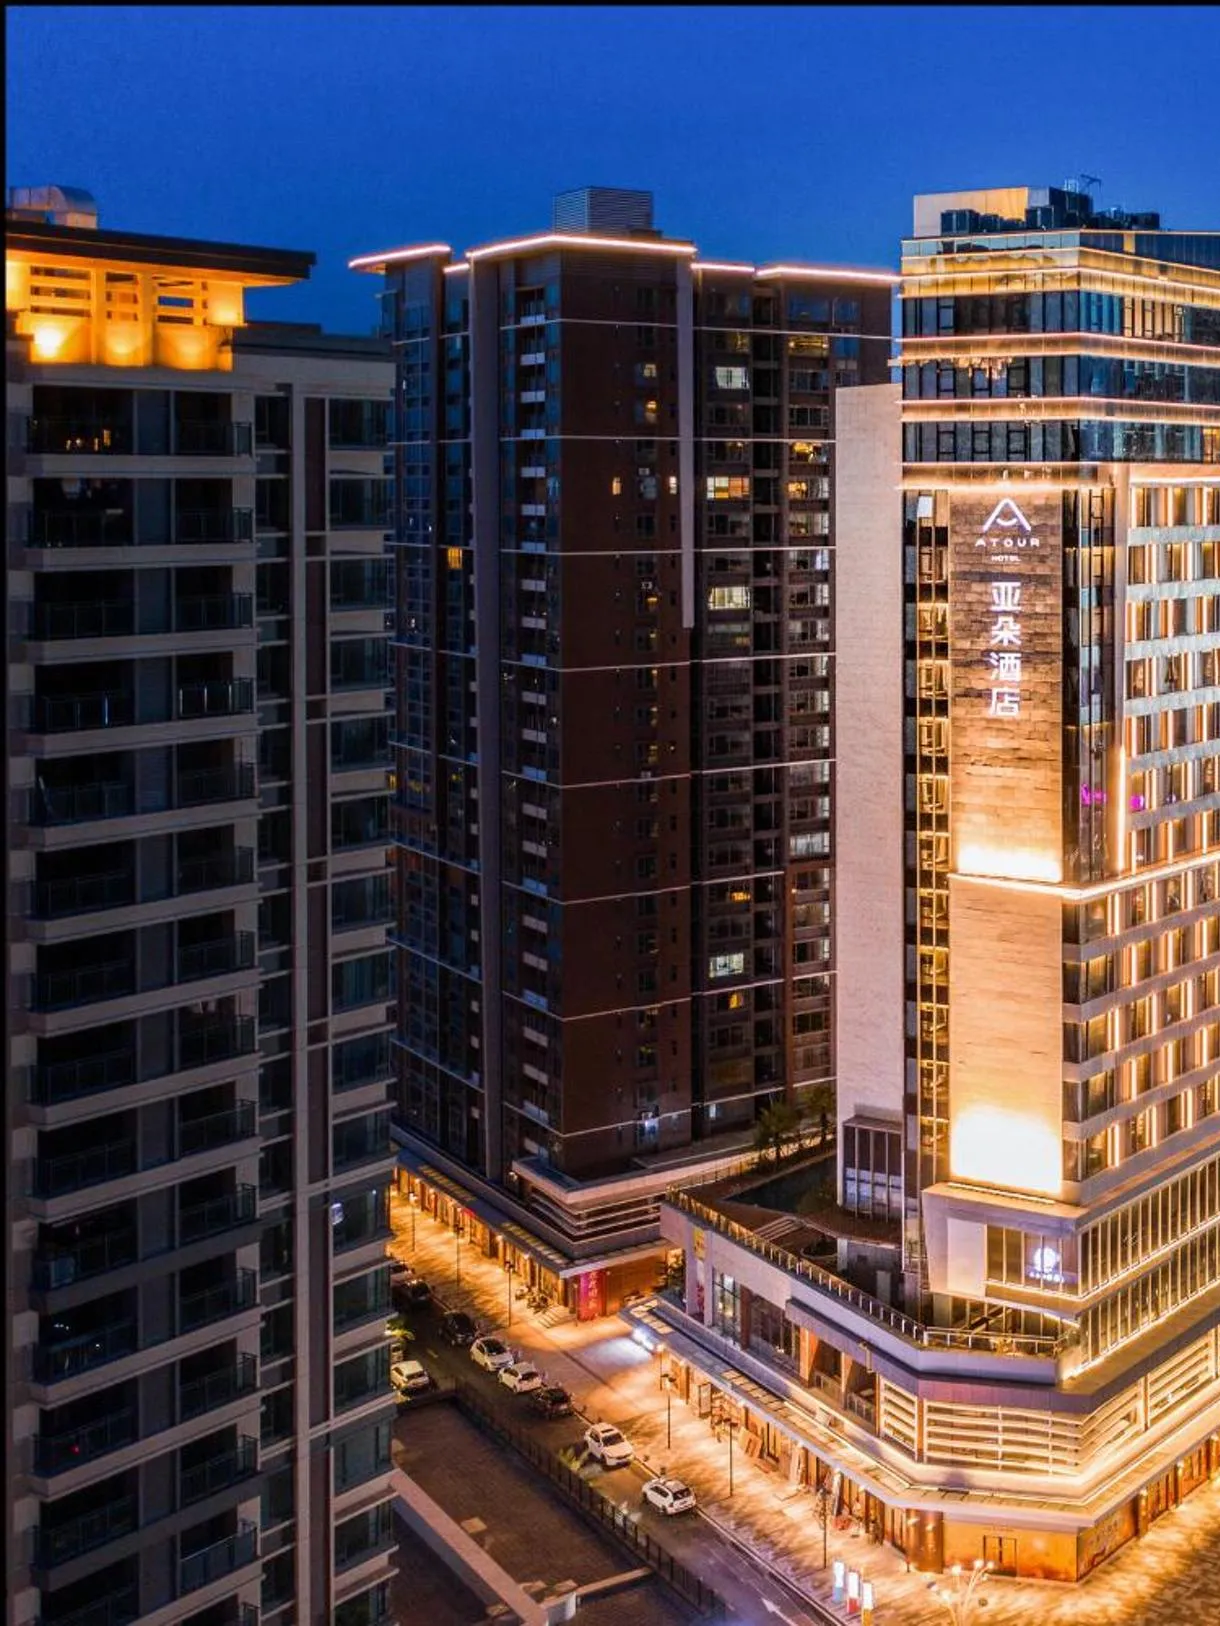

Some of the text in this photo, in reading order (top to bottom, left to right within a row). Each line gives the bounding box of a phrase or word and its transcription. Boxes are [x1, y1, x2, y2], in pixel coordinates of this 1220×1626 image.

[974, 537, 1040, 548] ATOUR
[991, 554, 1022, 562] HOTEL
[989, 581, 1022, 717] 亚朵酒店
